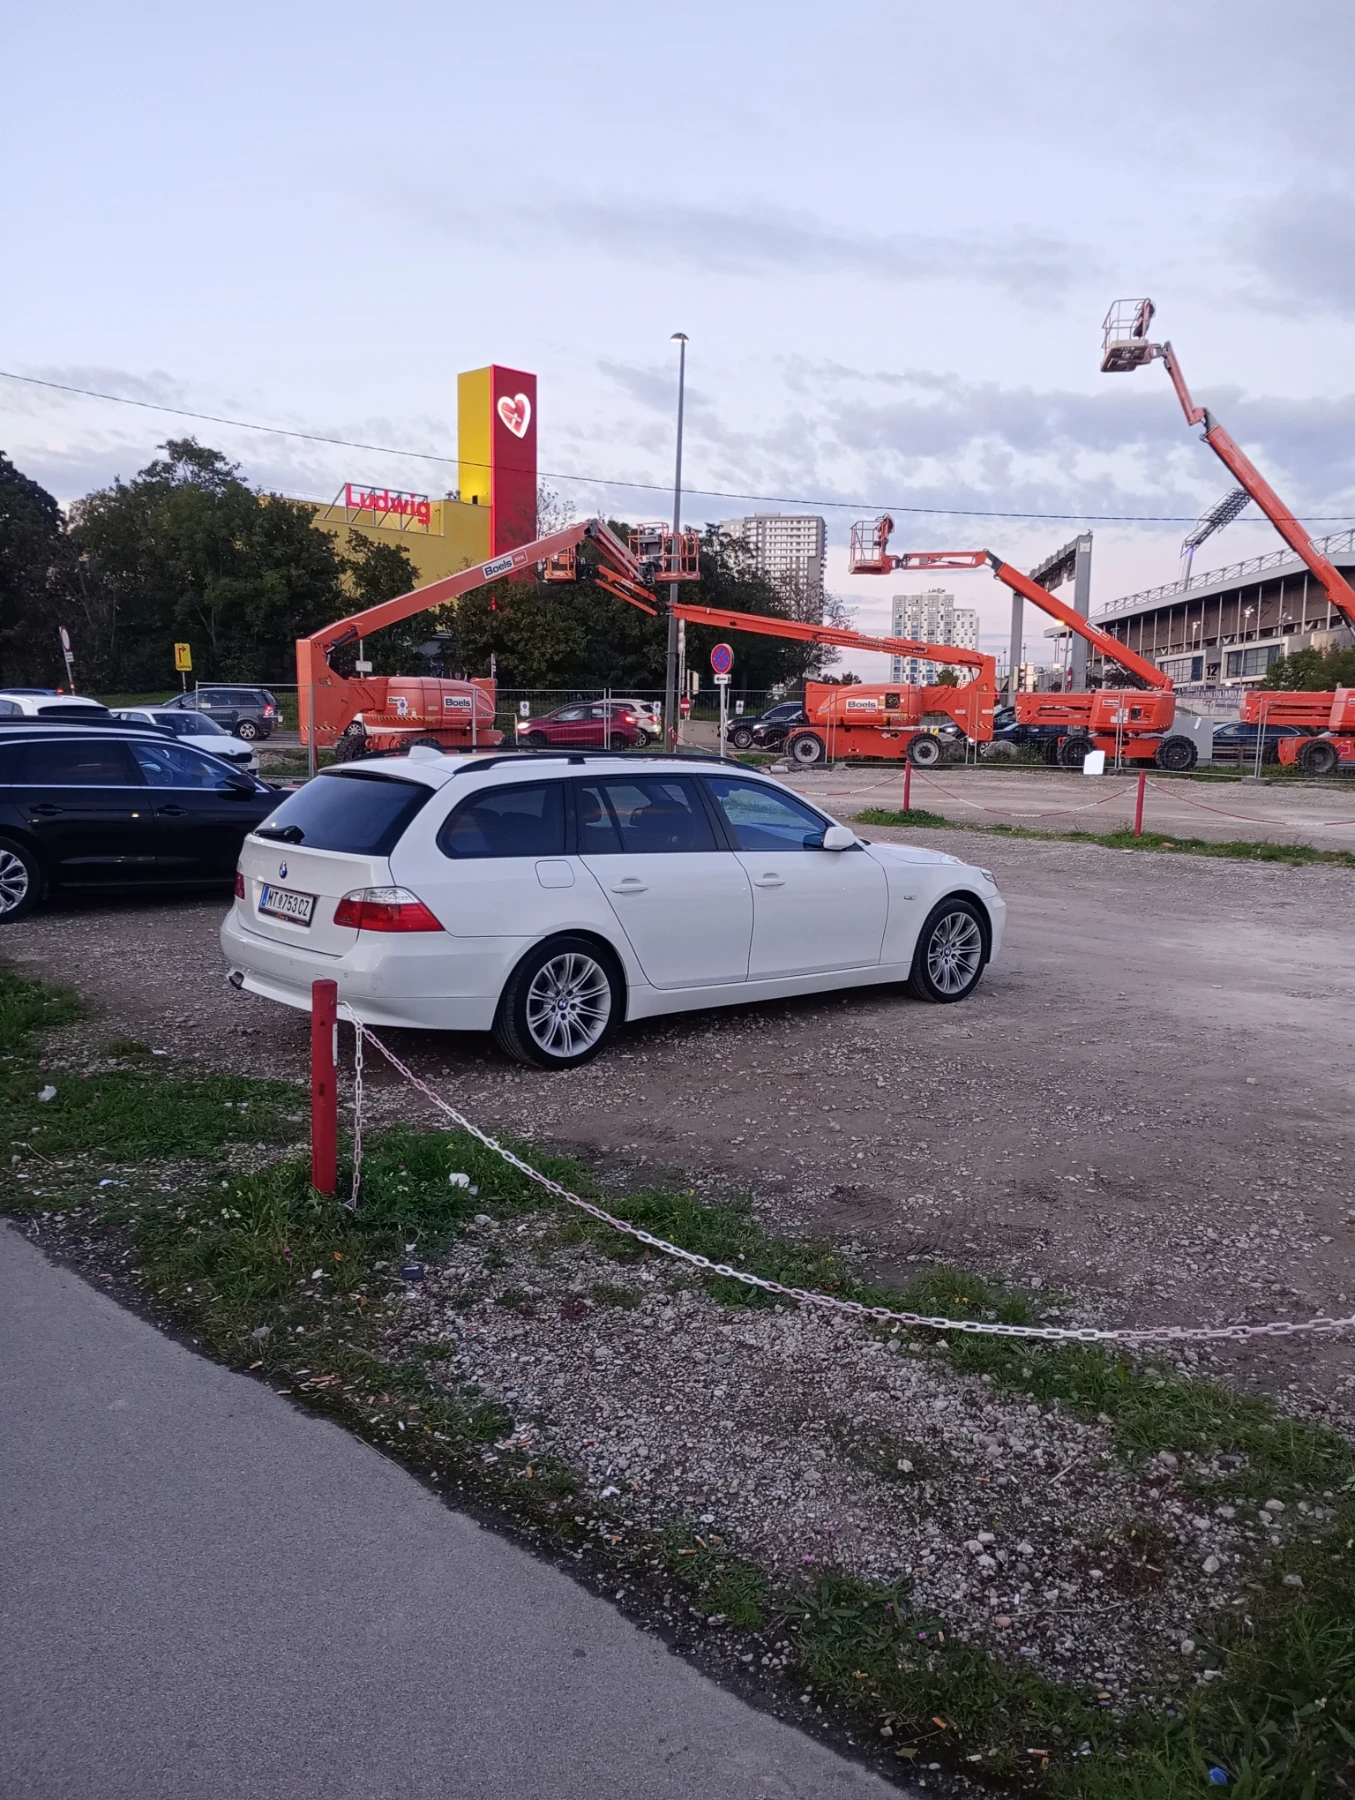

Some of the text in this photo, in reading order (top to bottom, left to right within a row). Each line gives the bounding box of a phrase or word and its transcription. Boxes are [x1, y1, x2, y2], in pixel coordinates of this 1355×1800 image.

[345, 483, 430, 525] Ludwig
[484, 560, 513, 576] Boels
[1206, 664, 1218, 676] 12
[445, 698, 471, 707] Boels
[848, 700, 876, 708] Boels
